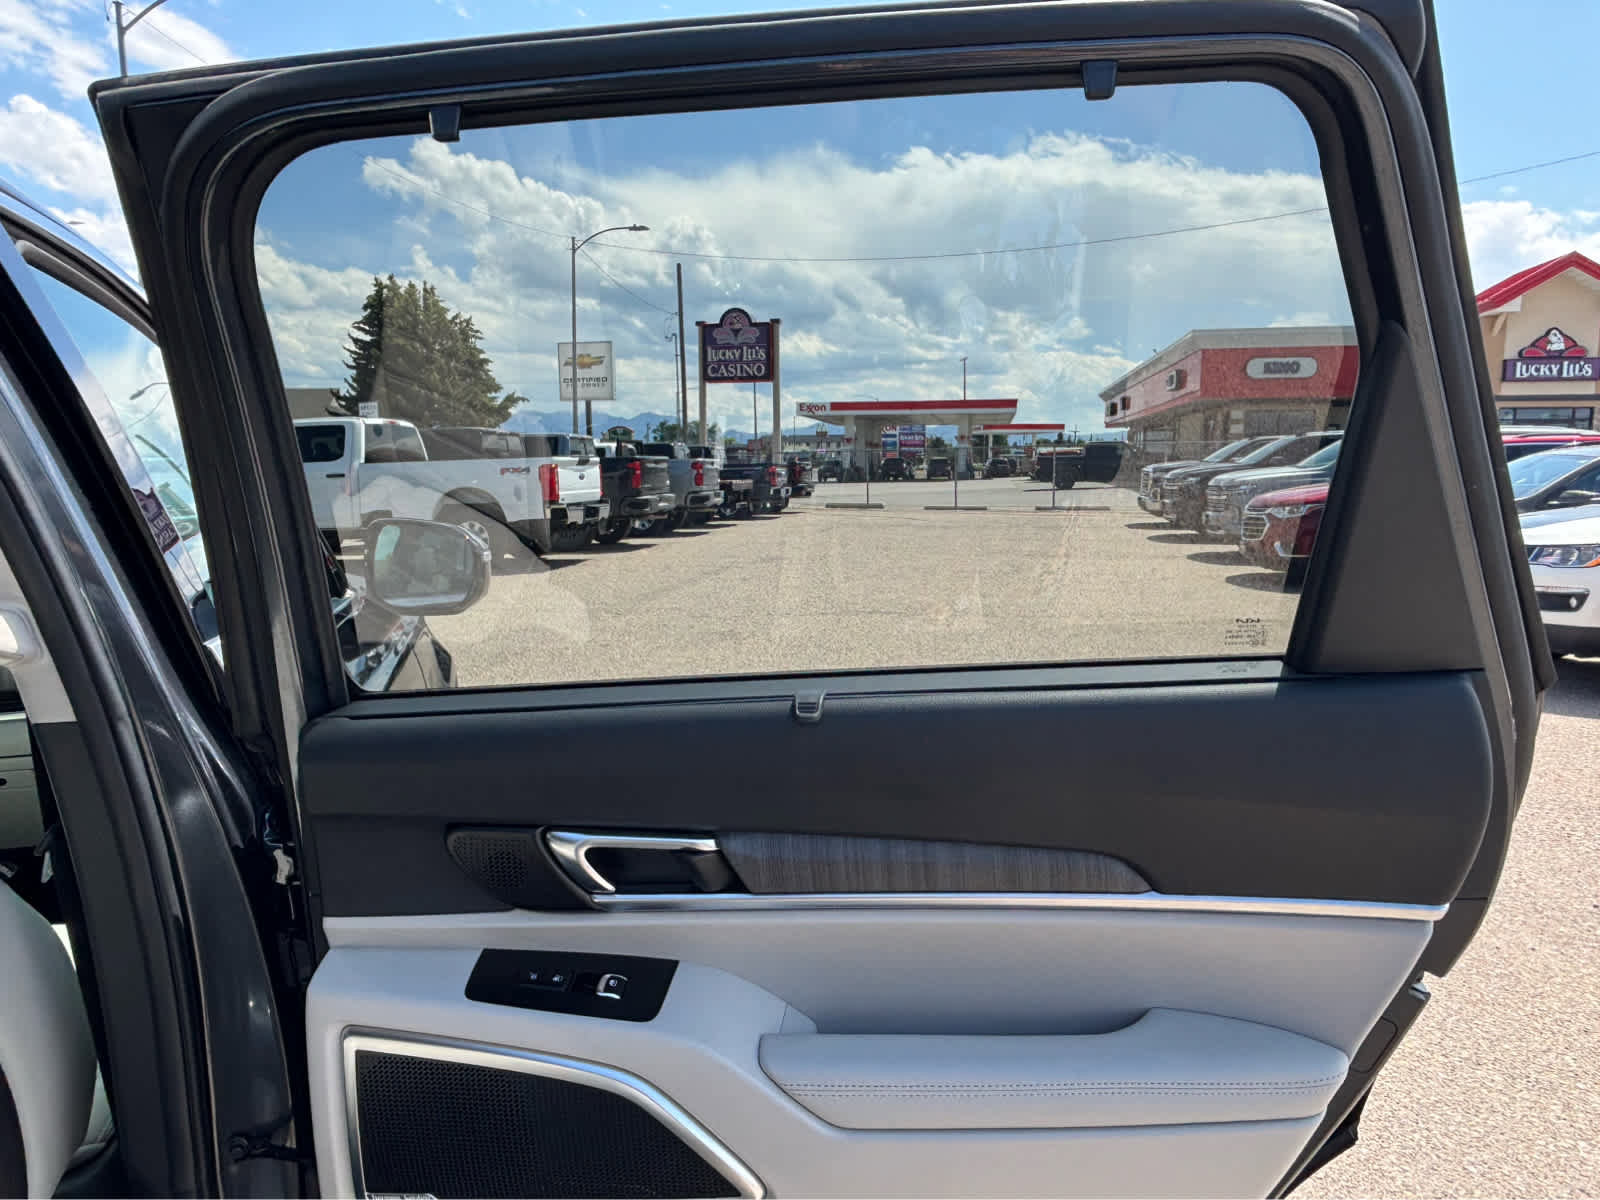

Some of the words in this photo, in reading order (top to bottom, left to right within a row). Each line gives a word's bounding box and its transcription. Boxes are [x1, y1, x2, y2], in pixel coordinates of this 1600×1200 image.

[706, 363, 766, 377] CASINO
[1515, 361, 1560, 378] LUCKY
[1562, 361, 1593, 378] LIL'S
[799, 402, 827, 414] Exxon
